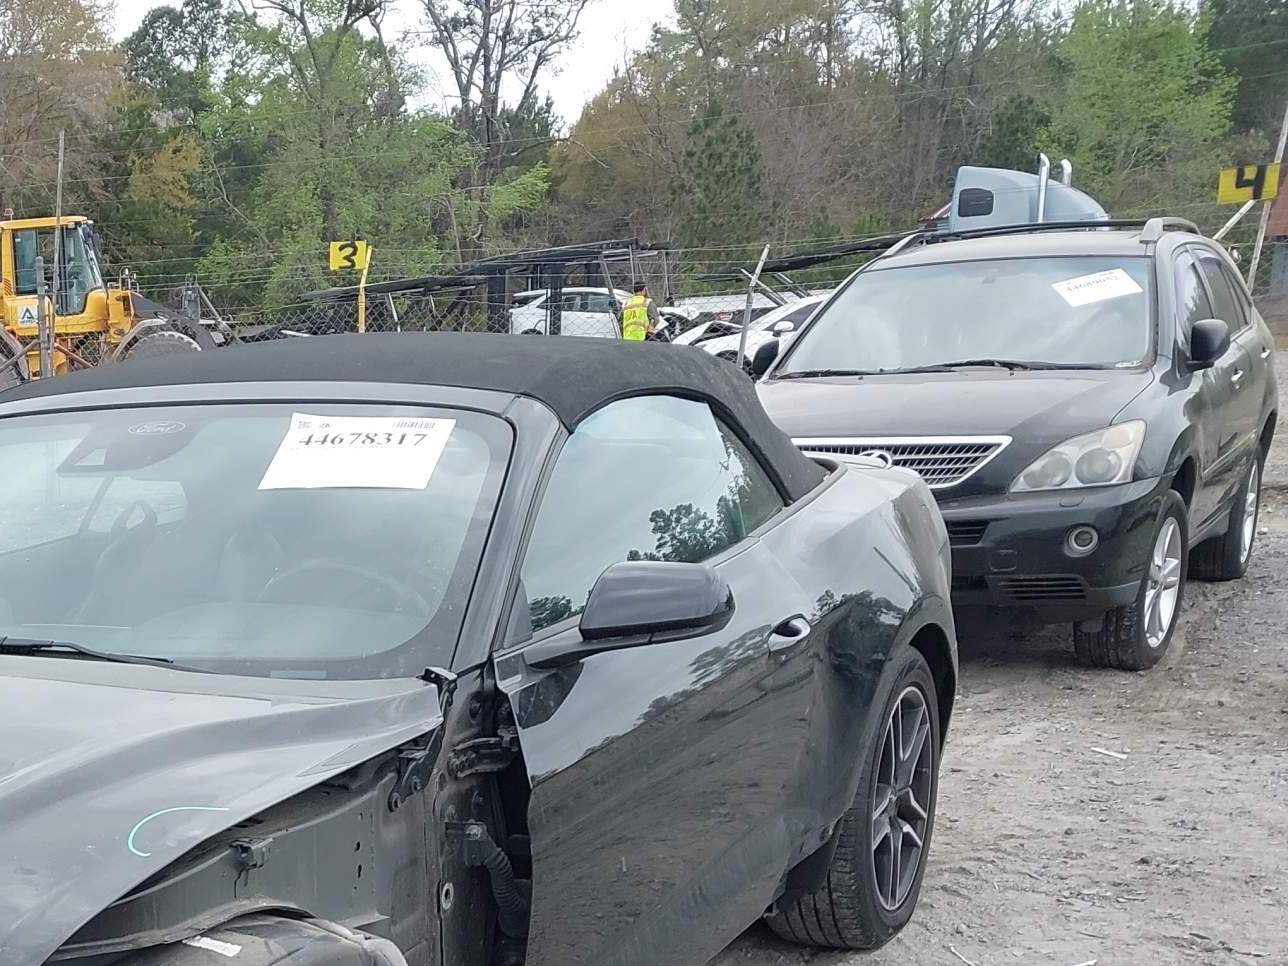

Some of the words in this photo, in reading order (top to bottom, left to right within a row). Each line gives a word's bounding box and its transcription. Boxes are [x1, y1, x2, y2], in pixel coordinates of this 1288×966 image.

[1235, 163, 1268, 200] 4
[338, 242, 358, 269] 3
[298, 432, 428, 446] 44678317
